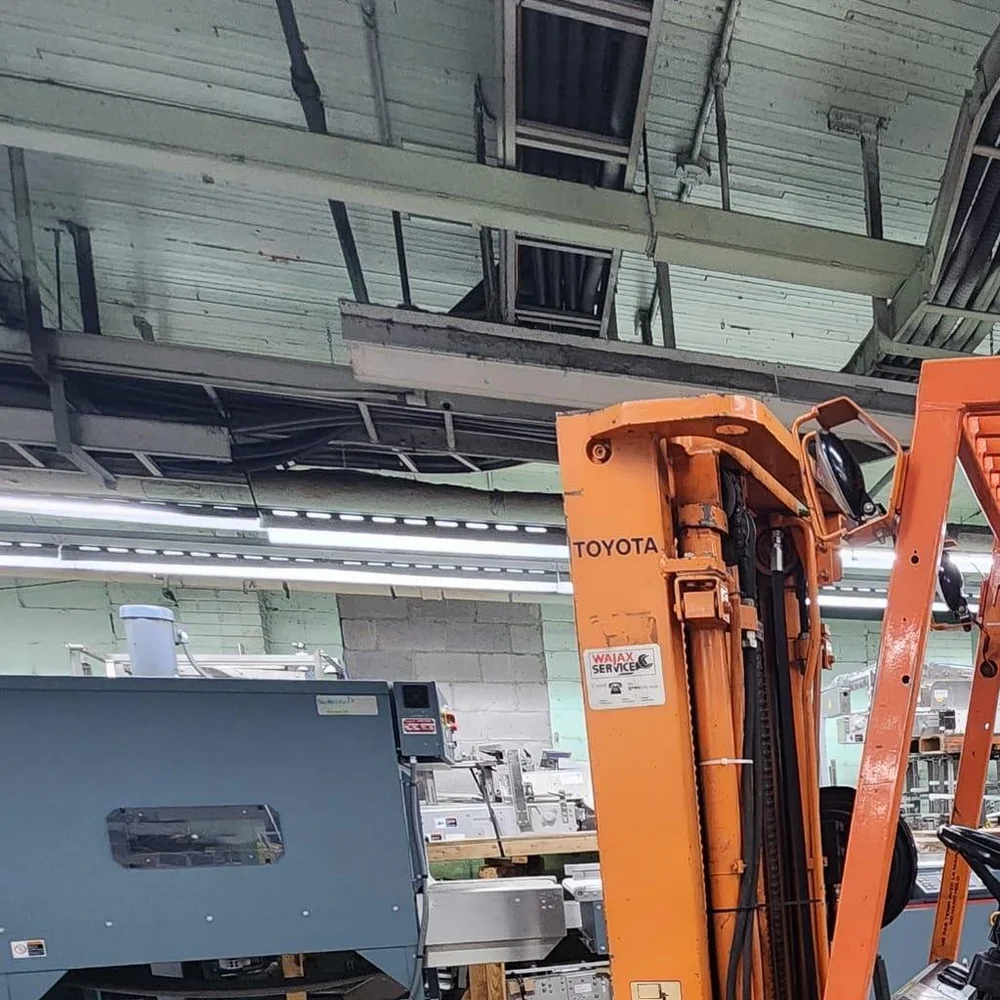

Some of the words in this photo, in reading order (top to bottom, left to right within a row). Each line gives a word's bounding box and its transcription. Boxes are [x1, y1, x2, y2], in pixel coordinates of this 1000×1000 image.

[573, 537, 658, 558] TOYOTA
[592, 652, 633, 664] WAJAX
[592, 662, 636, 674] SERVICE
